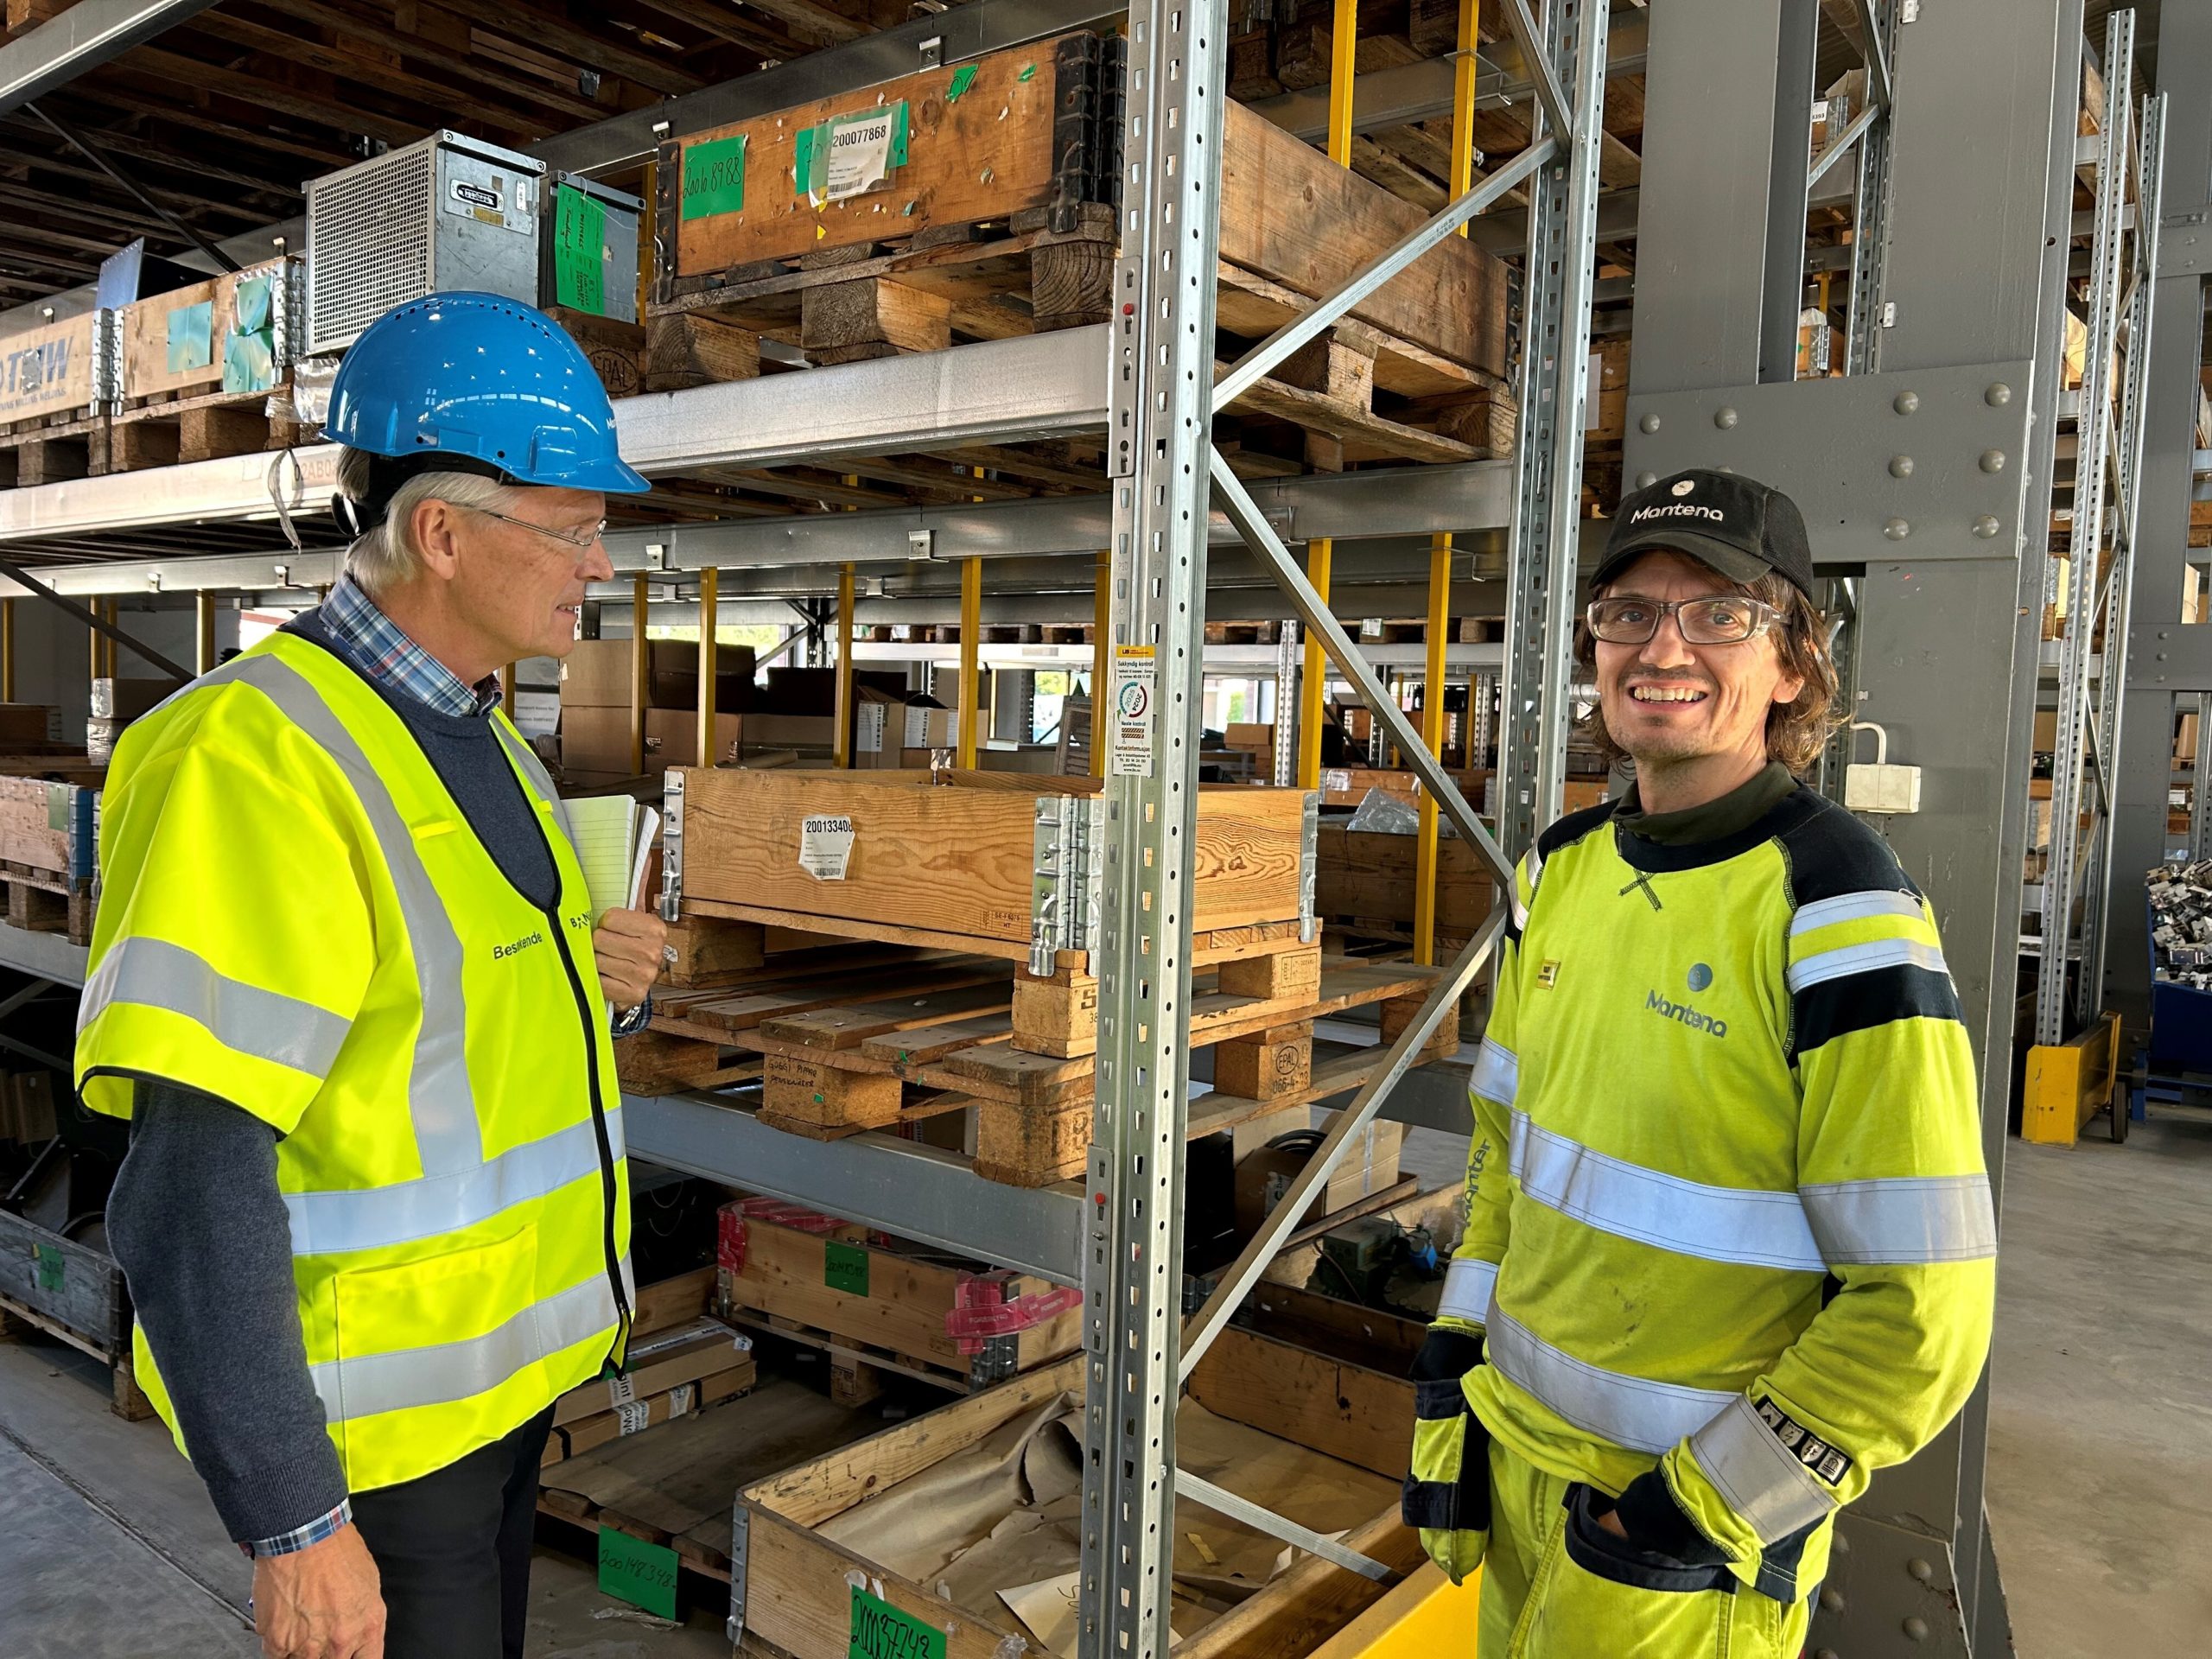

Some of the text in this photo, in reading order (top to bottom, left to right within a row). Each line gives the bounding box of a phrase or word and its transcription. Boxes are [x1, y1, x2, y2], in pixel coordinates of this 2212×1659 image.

[833, 125, 887, 148] 200077868
[1630, 502, 1724, 524] Mantena
[1124, 689, 1135, 707] 2025
[1132, 693, 1142, 711] 2024
[1644, 988, 1727, 1039] Mantena
[1279, 1052, 1296, 1069] EPAL
